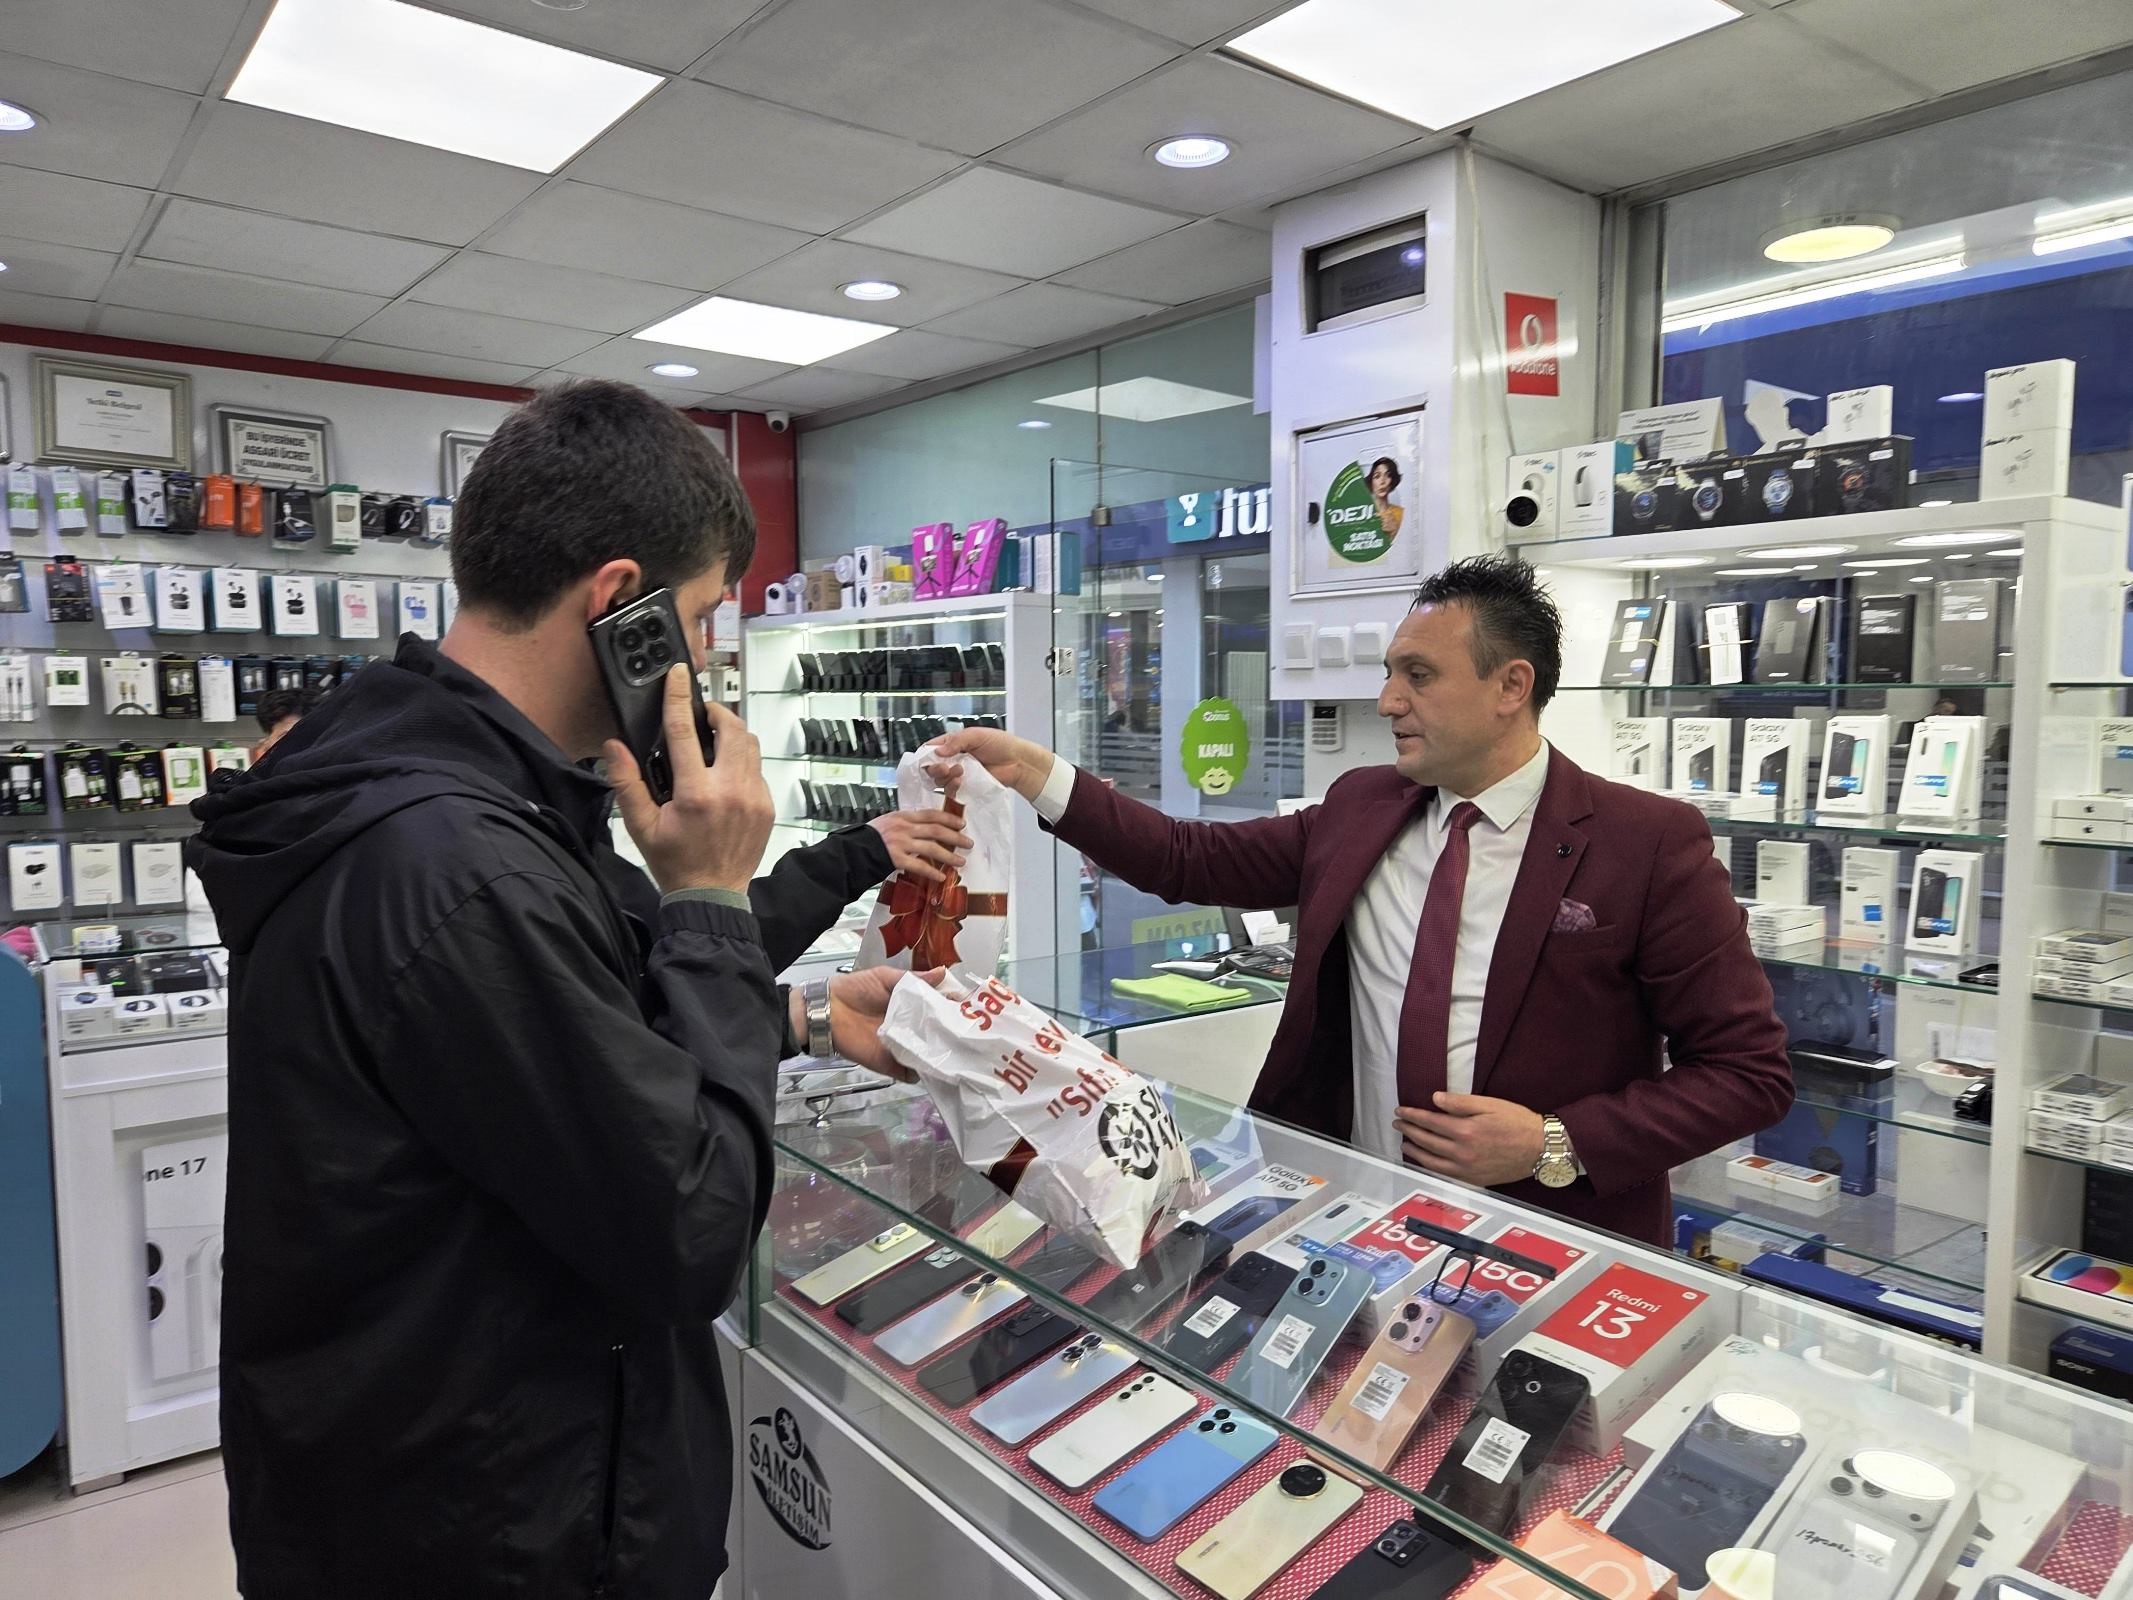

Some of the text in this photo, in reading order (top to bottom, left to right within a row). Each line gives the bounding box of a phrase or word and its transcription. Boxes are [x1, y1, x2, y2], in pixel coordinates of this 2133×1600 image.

[1678, 723, 1710, 733] Galaxy
[1750, 723, 1786, 733] Galaxy
[1198, 743, 1234, 759] KAPALI
[994, 1049, 1039, 1095] bir
[144, 1156, 208, 1182] ne 17
[1268, 1165, 1316, 1188] Galaxy
[1471, 1252, 1544, 1292] 15C
[1605, 1288, 1662, 1313] Redmi
[1577, 1300, 1647, 1339] 13
[749, 1432, 832, 1533] SAMSUN
